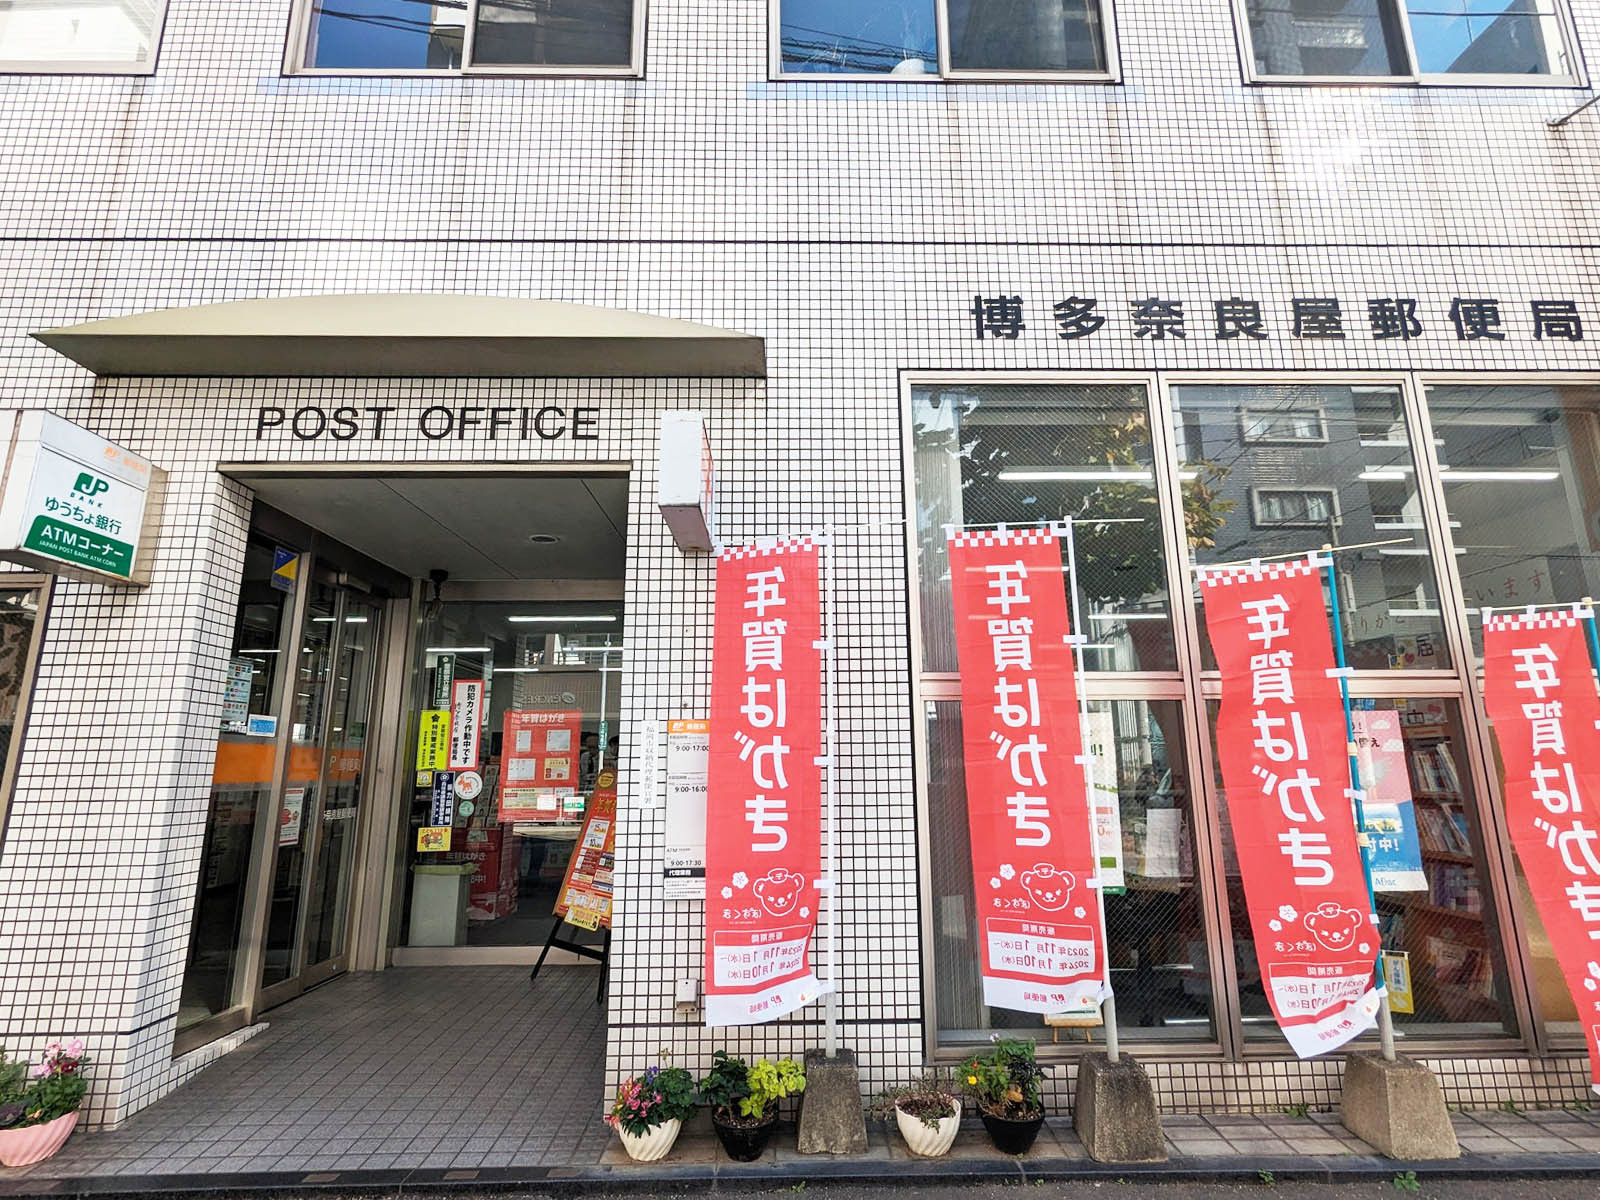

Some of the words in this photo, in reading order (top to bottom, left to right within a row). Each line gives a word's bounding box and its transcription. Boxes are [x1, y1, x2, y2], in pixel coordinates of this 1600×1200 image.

[972, 295, 1584, 341] 博多奈良屋郵便局
[256, 406, 395, 440] POST
[420, 406, 600, 440] OFFICE
[45, 496, 123, 535] ゆうちょ銀行
[69, 492, 104, 509] BANK
[39, 540, 58, 550] JAPAN
[58, 546, 73, 555] POST
[73, 550, 90, 560] BANK
[41, 525, 125, 558] ATMコーナー
[462, 684, 476, 765] 防犯カメラ作動中です
[521, 713, 565, 723] 年賀はがき
